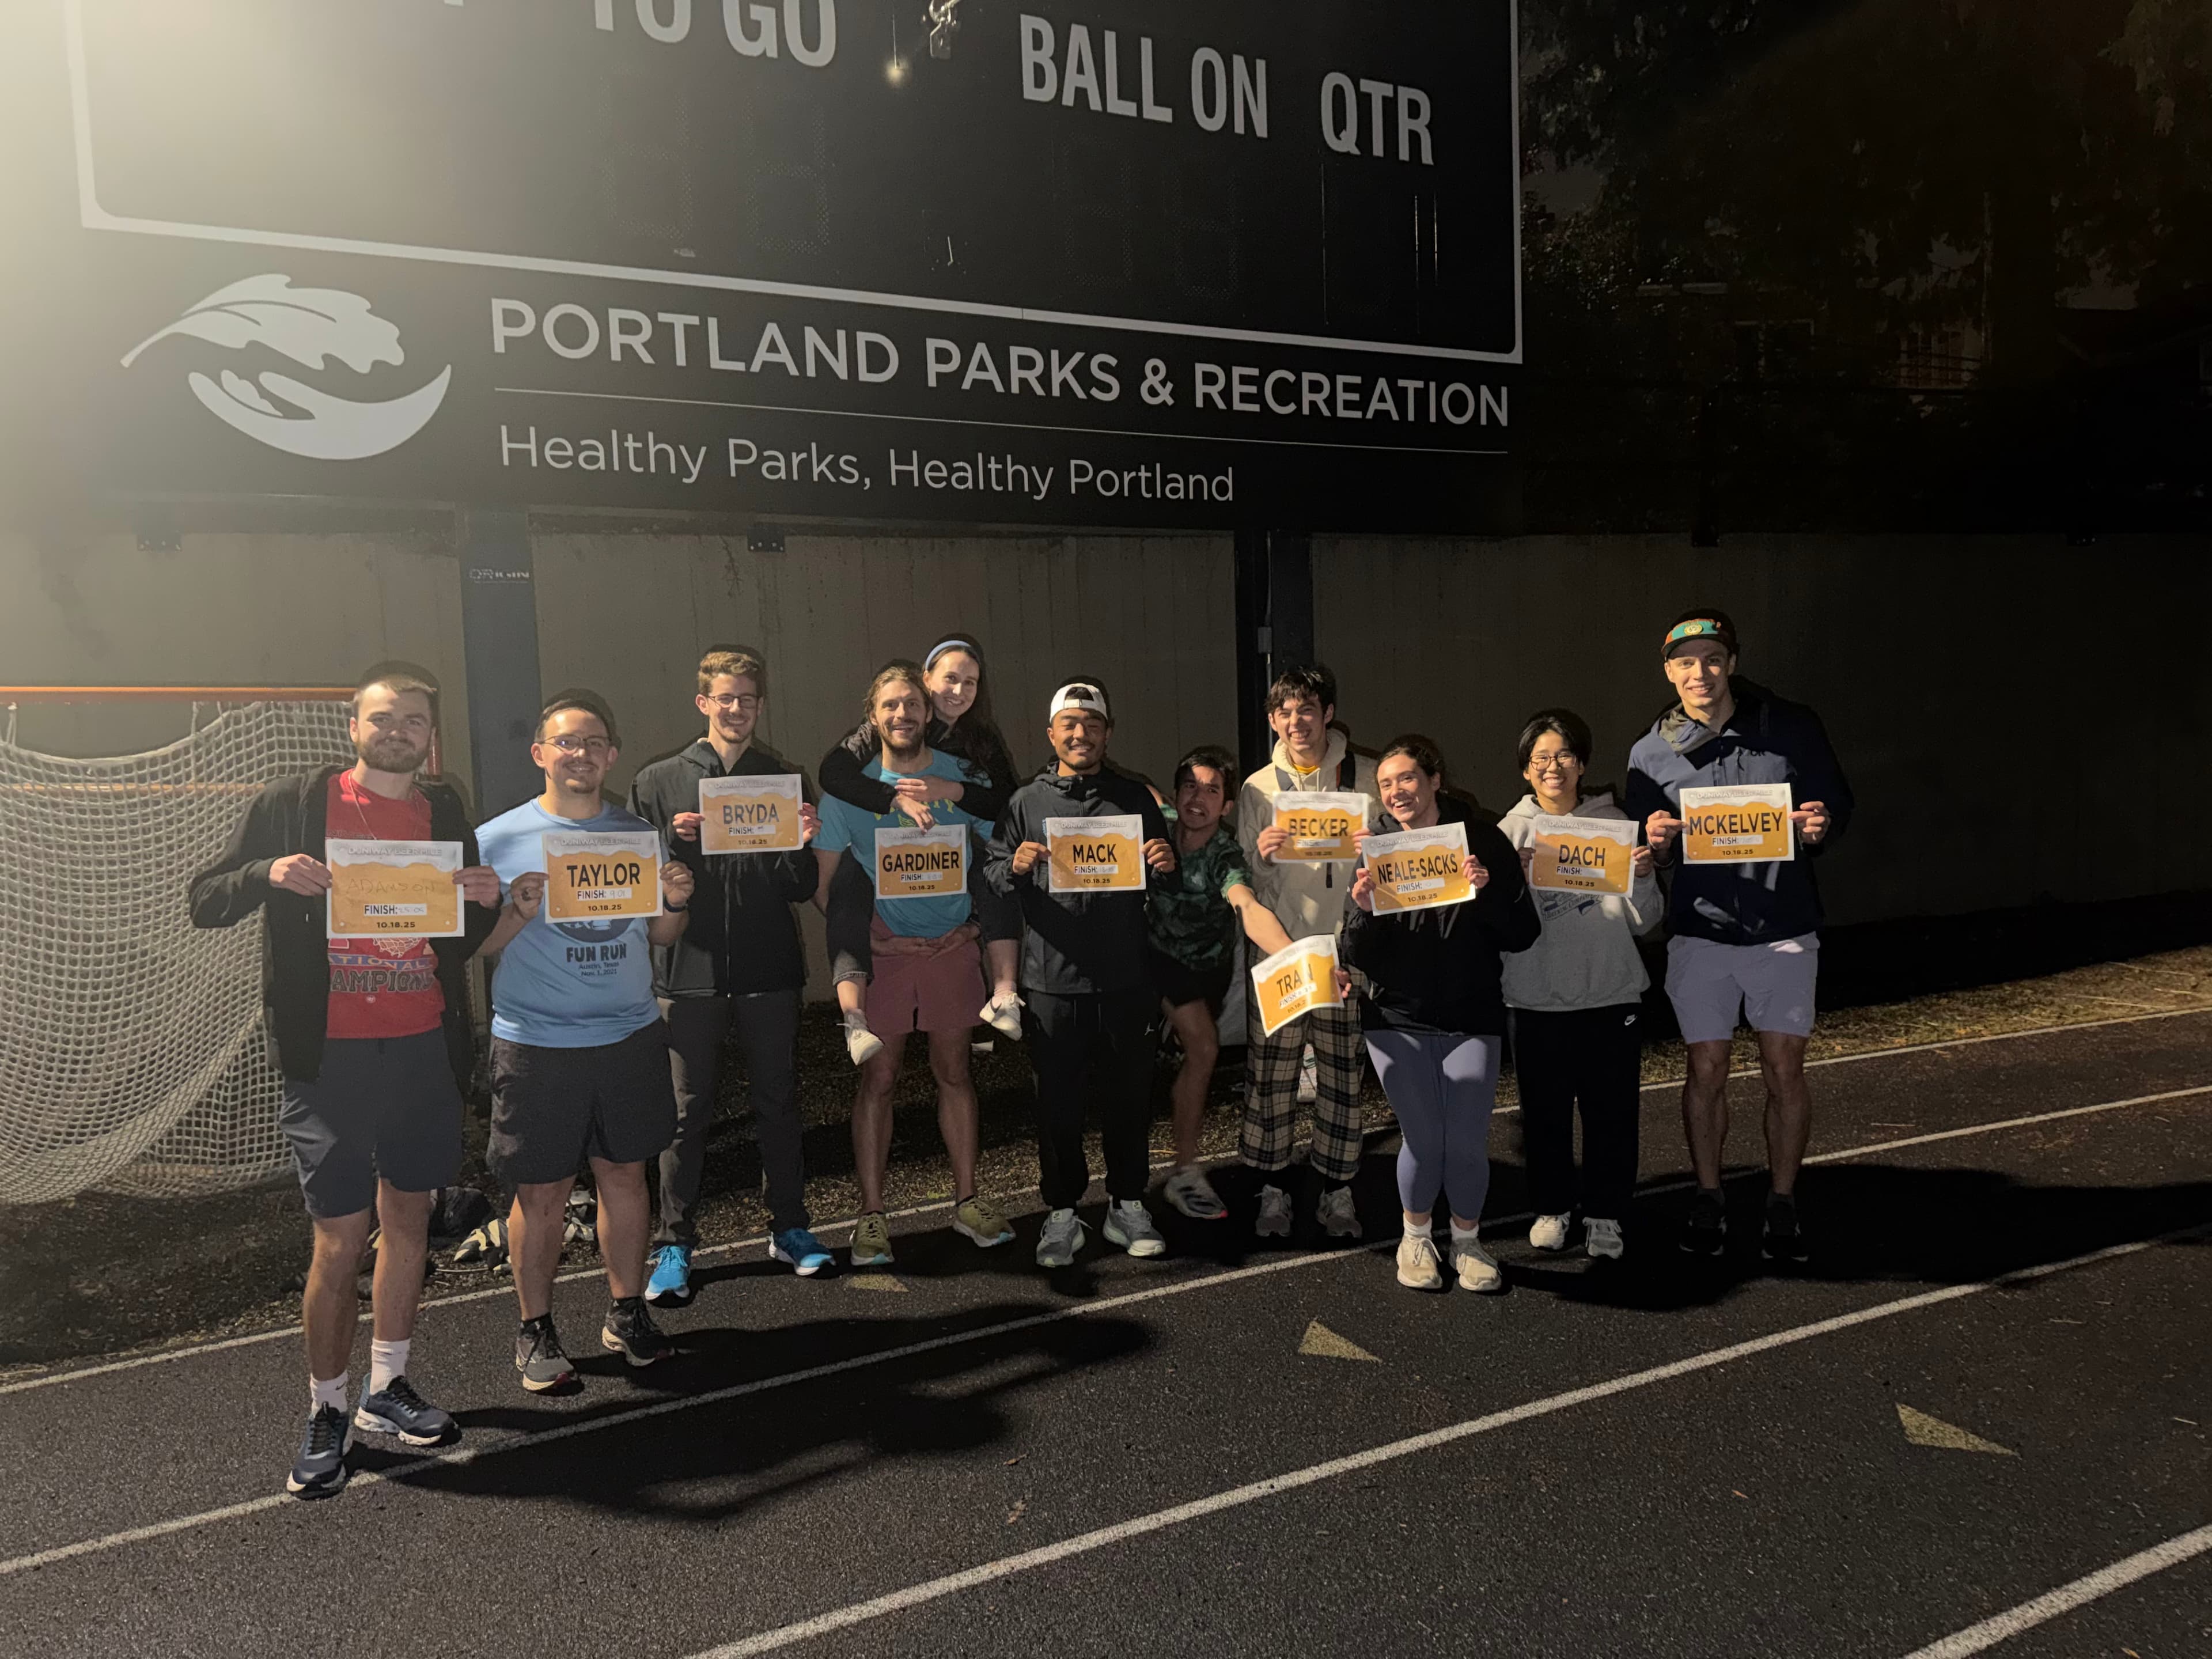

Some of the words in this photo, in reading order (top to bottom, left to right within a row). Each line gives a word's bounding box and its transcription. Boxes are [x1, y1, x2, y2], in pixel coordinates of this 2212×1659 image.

[722, 0, 836, 68] GO
[1020, 13, 1173, 123] BALL
[1191, 46, 1268, 138] ON
[1320, 71, 1434, 165] QTR
[491, 297, 900, 383] PORTLAND
[925, 337, 1120, 402] PARKS
[1139, 358, 1175, 406] &
[1194, 362, 1508, 427] RECREATION
[500, 424, 707, 484] Healthy
[728, 437, 871, 490] Parks,
[889, 448, 1054, 500] Healthy
[1070, 459, 1233, 501] Portland
[722, 802, 779, 824] BRYDA
[1689, 811, 1783, 835] MCKELVEY
[729, 827, 755, 835] FINISH:
[1288, 818, 1349, 837] BECKER
[1712, 836, 1739, 846] FINISH:
[882, 851, 960, 873] GARDINER
[1072, 843, 1118, 863] MACK
[1558, 844, 1606, 867] DACH
[566, 862, 641, 887] TAYLOR
[1074, 865, 1098, 874] FINISH:
[1377, 853, 1458, 885] NEALE-SACKS
[1556, 866, 1582, 875] FINISH:
[577, 889, 607, 900] FINISH:
[1396, 881, 1423, 892] FINISH:
[1407, 893, 1438, 903] 10.18.25
[364, 904, 398, 915] FINISH:
[566, 945, 596, 963] FUN
[600, 943, 627, 961] RUN
